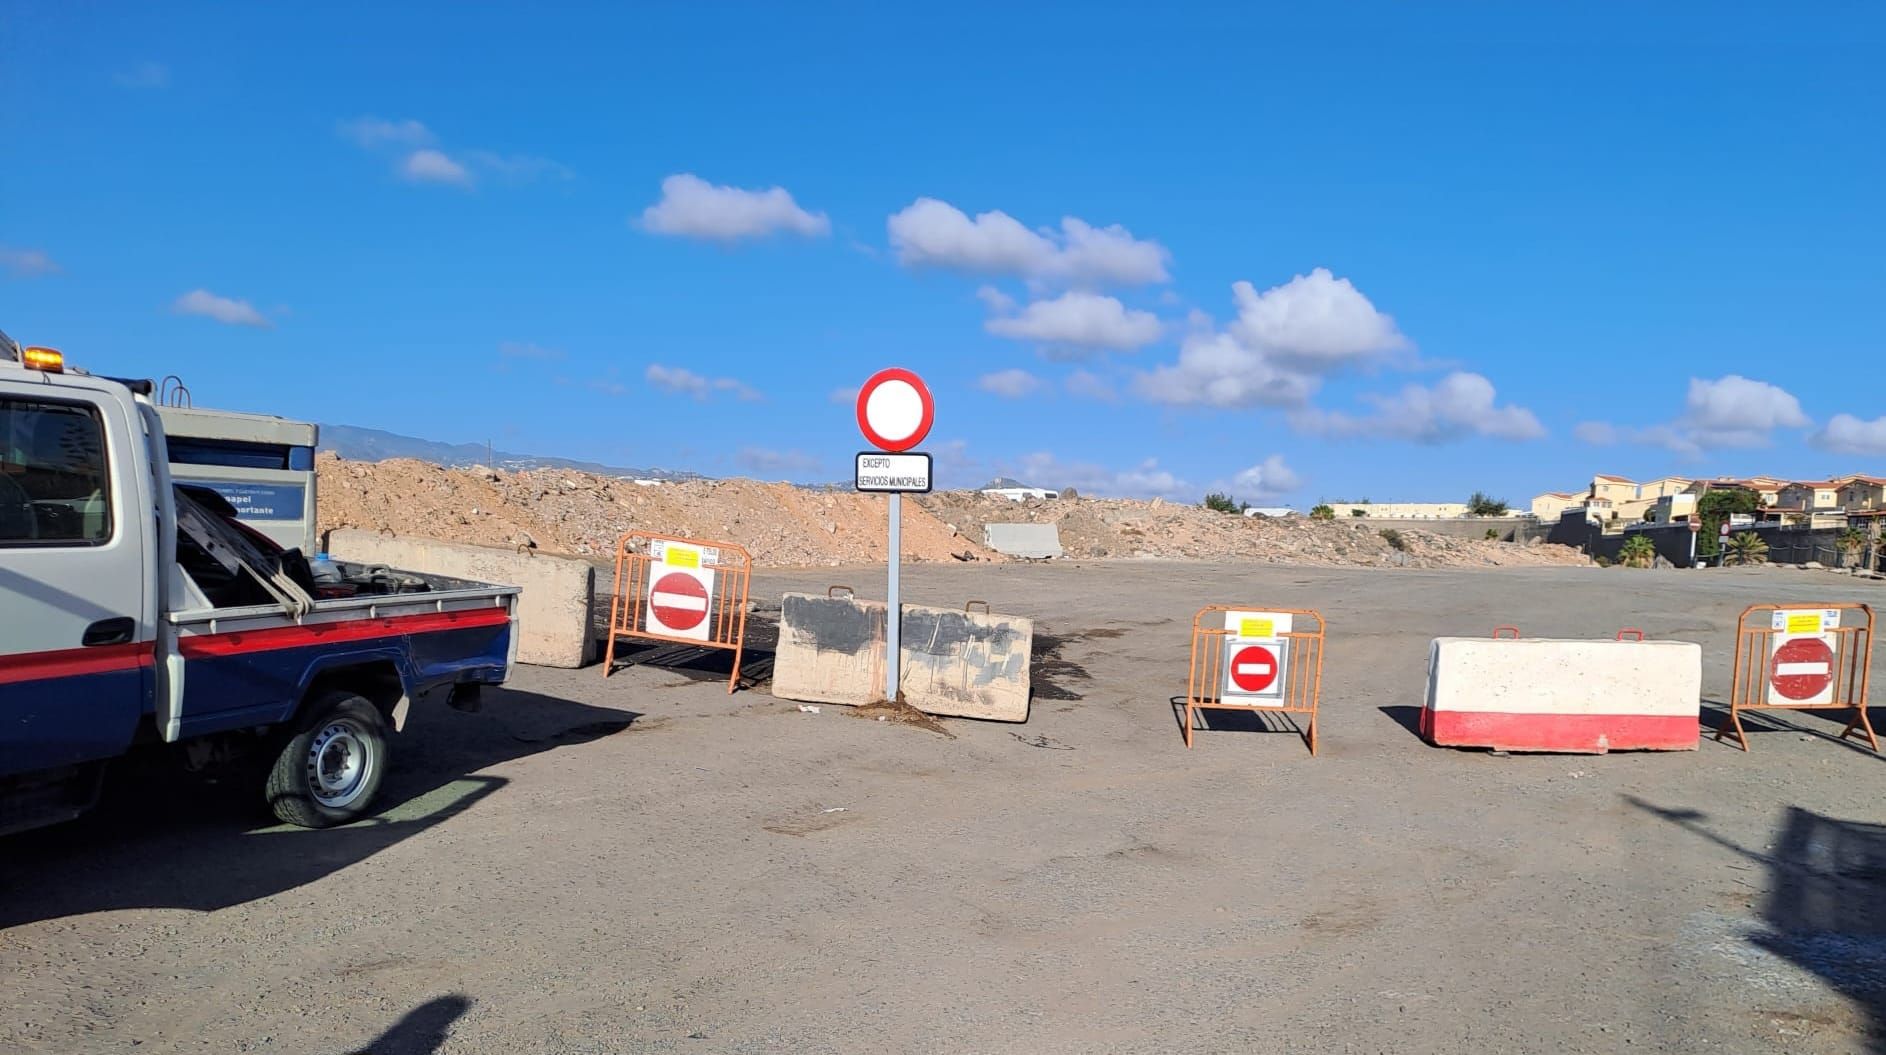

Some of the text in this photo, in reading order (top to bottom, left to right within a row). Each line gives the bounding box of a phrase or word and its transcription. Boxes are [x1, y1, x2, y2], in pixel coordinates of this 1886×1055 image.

[863, 458, 890, 468] EXCEPTO
[859, 475, 926, 487] SERVICIOS MUNICIPALES
